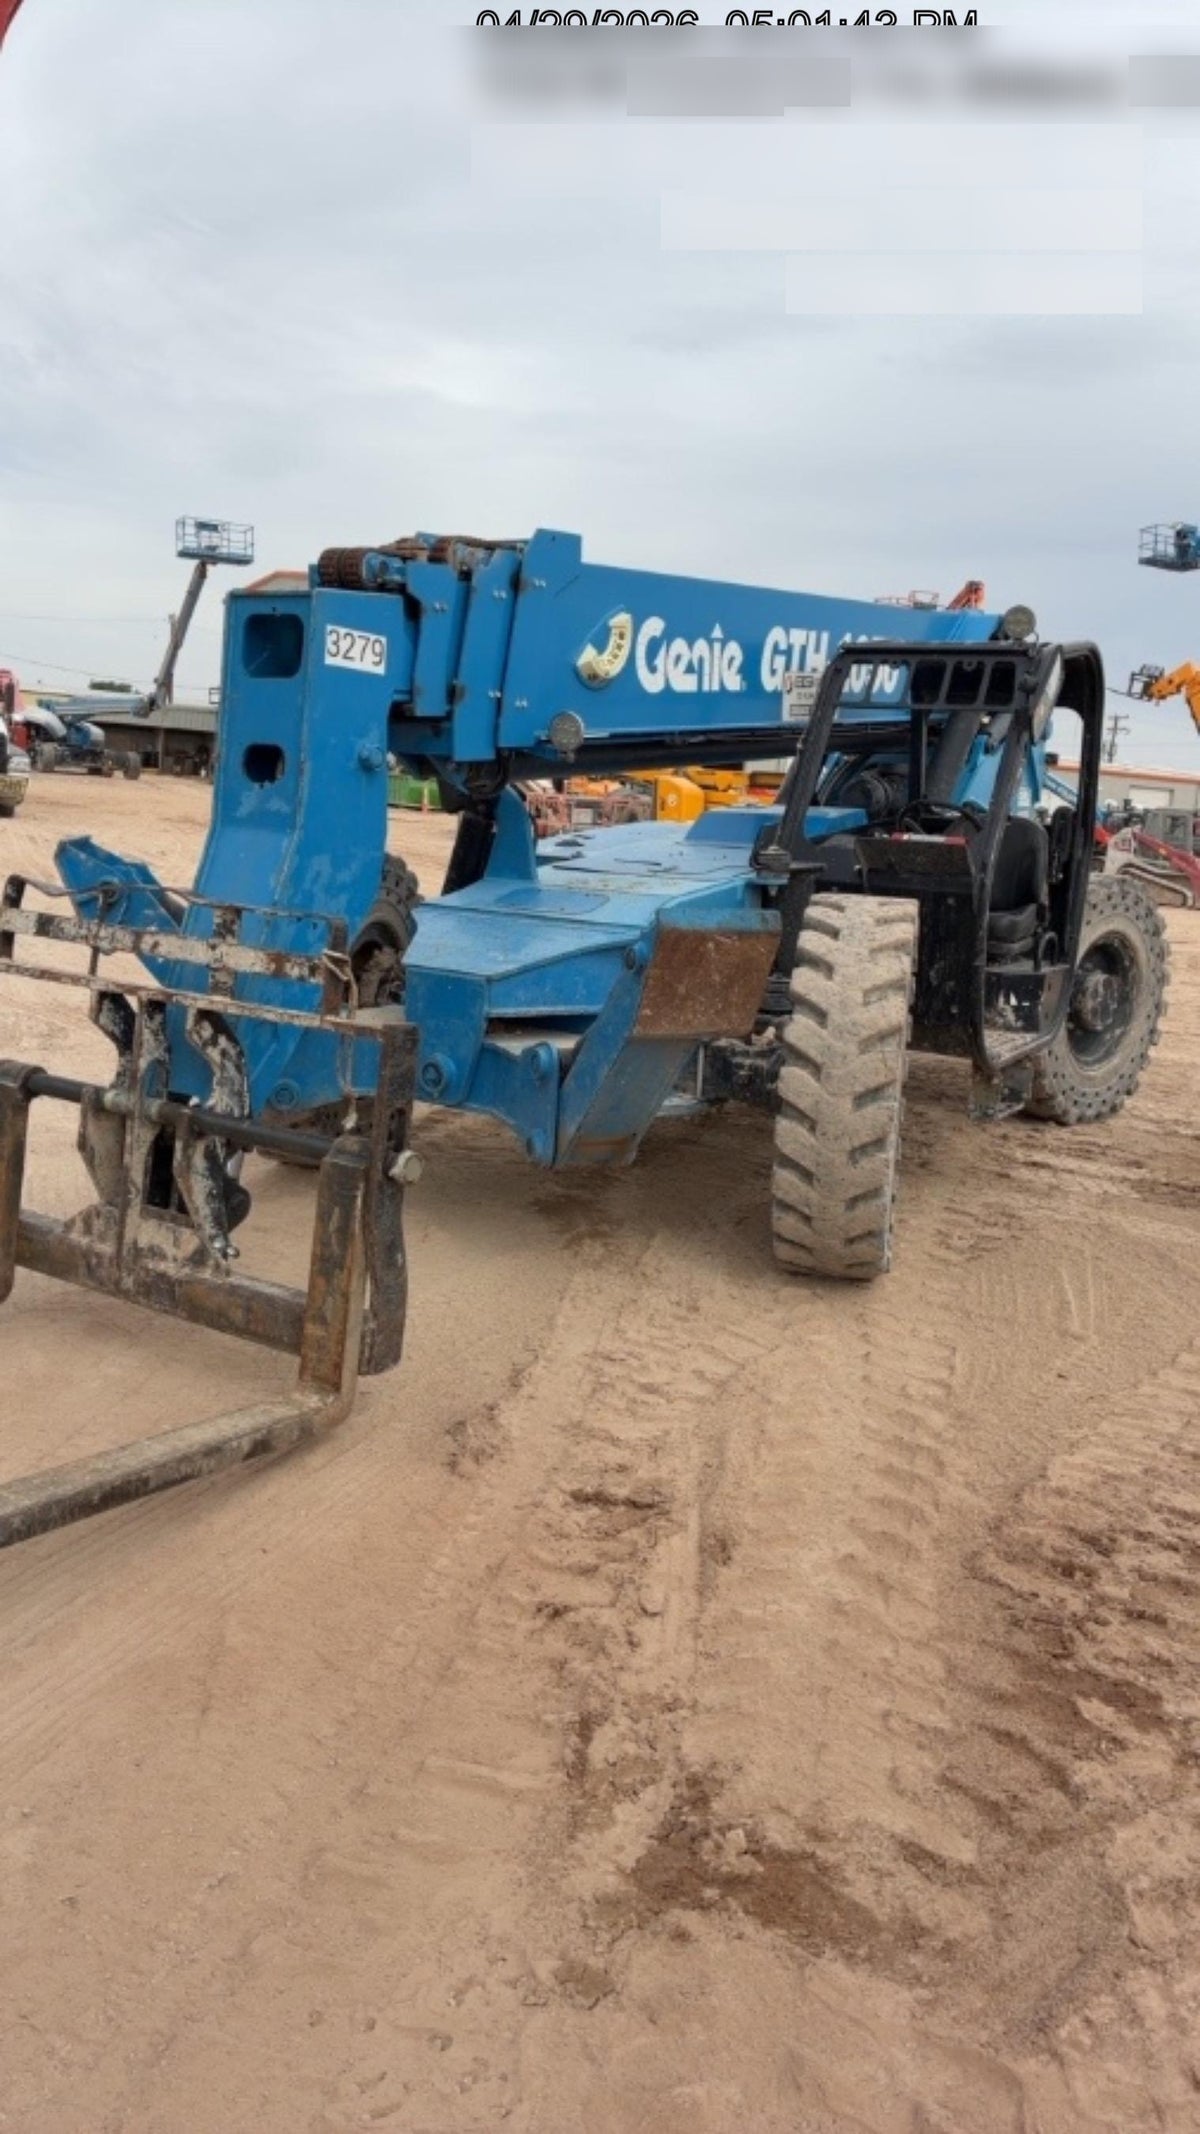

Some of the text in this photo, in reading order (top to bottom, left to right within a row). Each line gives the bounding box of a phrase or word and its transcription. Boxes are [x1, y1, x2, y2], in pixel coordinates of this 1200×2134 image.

[327, 628, 385, 667] 3279
[635, 616, 743, 693] Genie
[761, 625, 901, 693] GTH0
